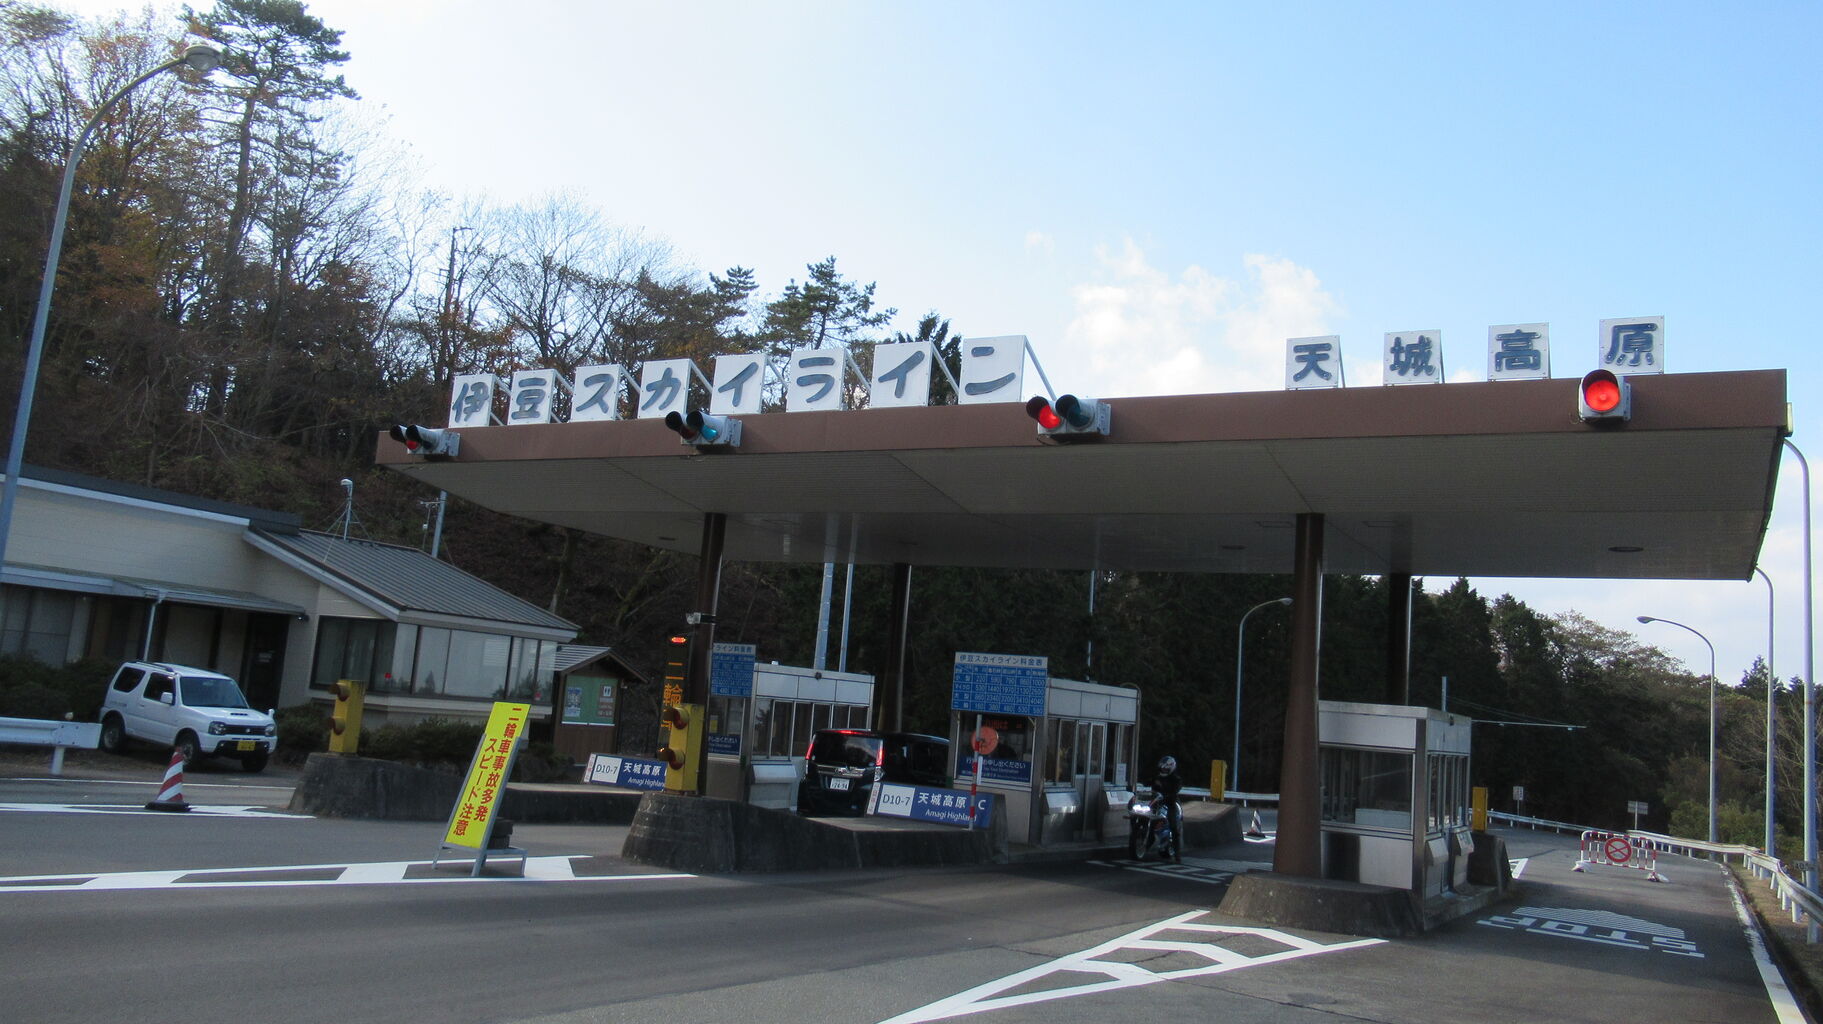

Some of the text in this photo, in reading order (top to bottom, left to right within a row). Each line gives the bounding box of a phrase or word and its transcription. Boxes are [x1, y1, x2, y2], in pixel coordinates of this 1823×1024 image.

[1293, 322, 1659, 382] 天城高原
[451, 345, 1017, 423] 伊豆スカイライン
[473, 707, 523, 822] 二輪車事故多発
[596, 763, 618, 775] D10-7
[623, 762, 662, 777] 天城高原
[453, 738, 498, 837] スピード注意
[644, 778, 666, 789] Highlan
[882, 793, 911, 806] D10-7
[917, 791, 968, 809] 天城高原
[925, 808, 947, 820] Amagi
[1475, 914, 1706, 959] STOP
